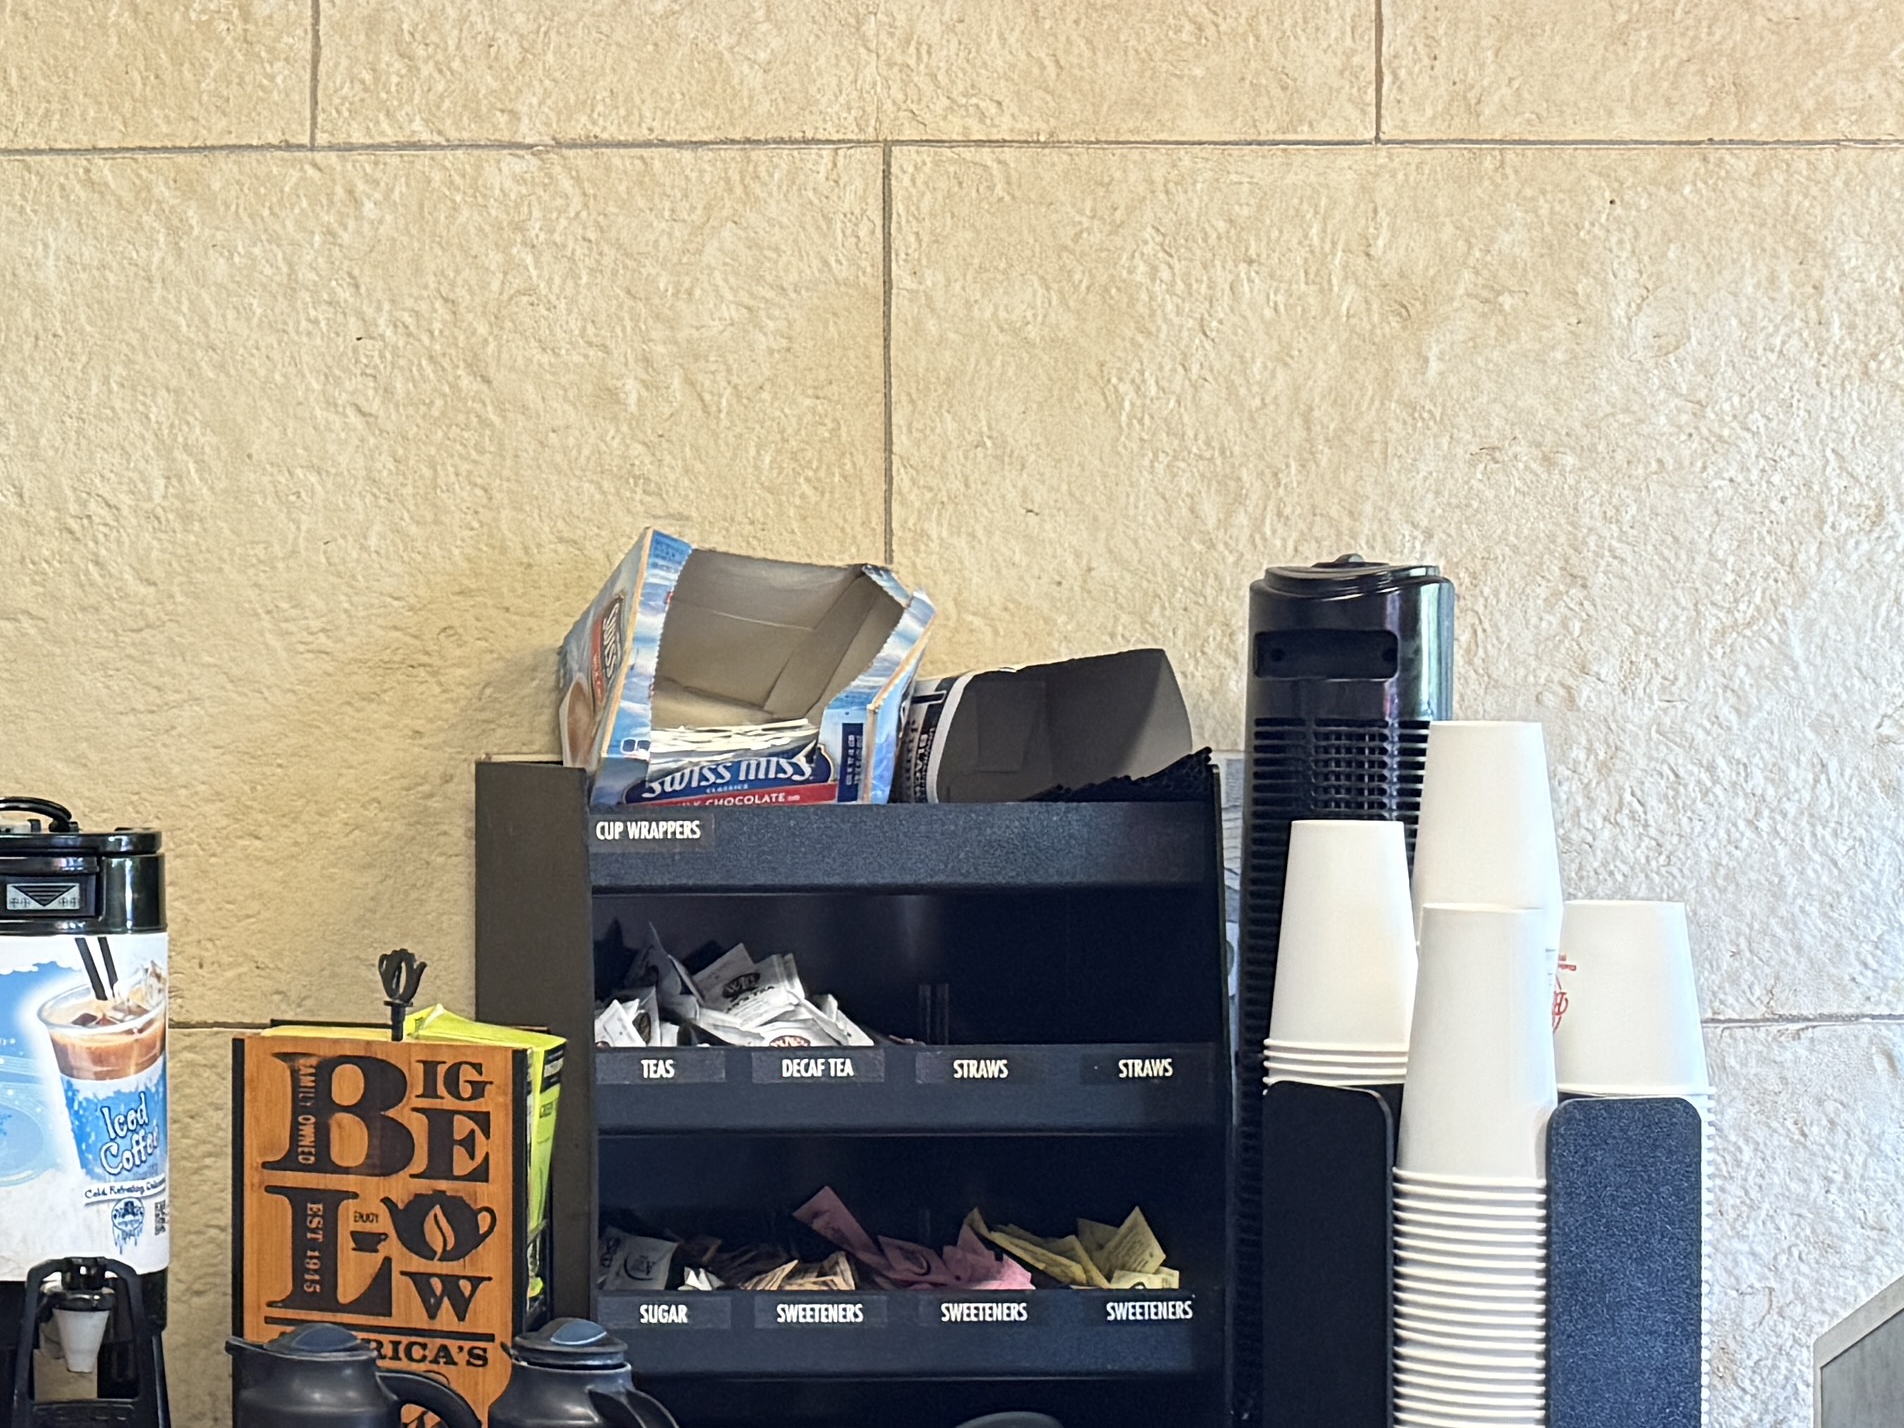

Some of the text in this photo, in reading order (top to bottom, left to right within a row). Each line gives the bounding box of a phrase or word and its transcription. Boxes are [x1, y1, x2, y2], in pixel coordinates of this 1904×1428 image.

[642, 760, 733, 799] SWISS
[738, 757, 812, 780] MISS
[704, 793, 786, 806] CHOCOLATE
[595, 820, 701, 840] CUP WRAPPERS
[641, 1059, 675, 1079] TEAS
[782, 1058, 854, 1078] DECAF TEA
[952, 1058, 1009, 1080] STRAWS
[1118, 1057, 1174, 1079] STRAWS
[101, 1091, 149, 1141] Iced
[297, 1115, 317, 1165] OWNED
[353, 1210, 379, 1224] ENJOY
[303, 1202, 323, 1293] EST 1945
[639, 1303, 688, 1324] SUGAR
[776, 1303, 864, 1324] SWEETENERS
[940, 1301, 1028, 1323] SWEETENERS
[1106, 1300, 1194, 1322] SWEETENERS
[369, 1338, 488, 1368] RICA'S
